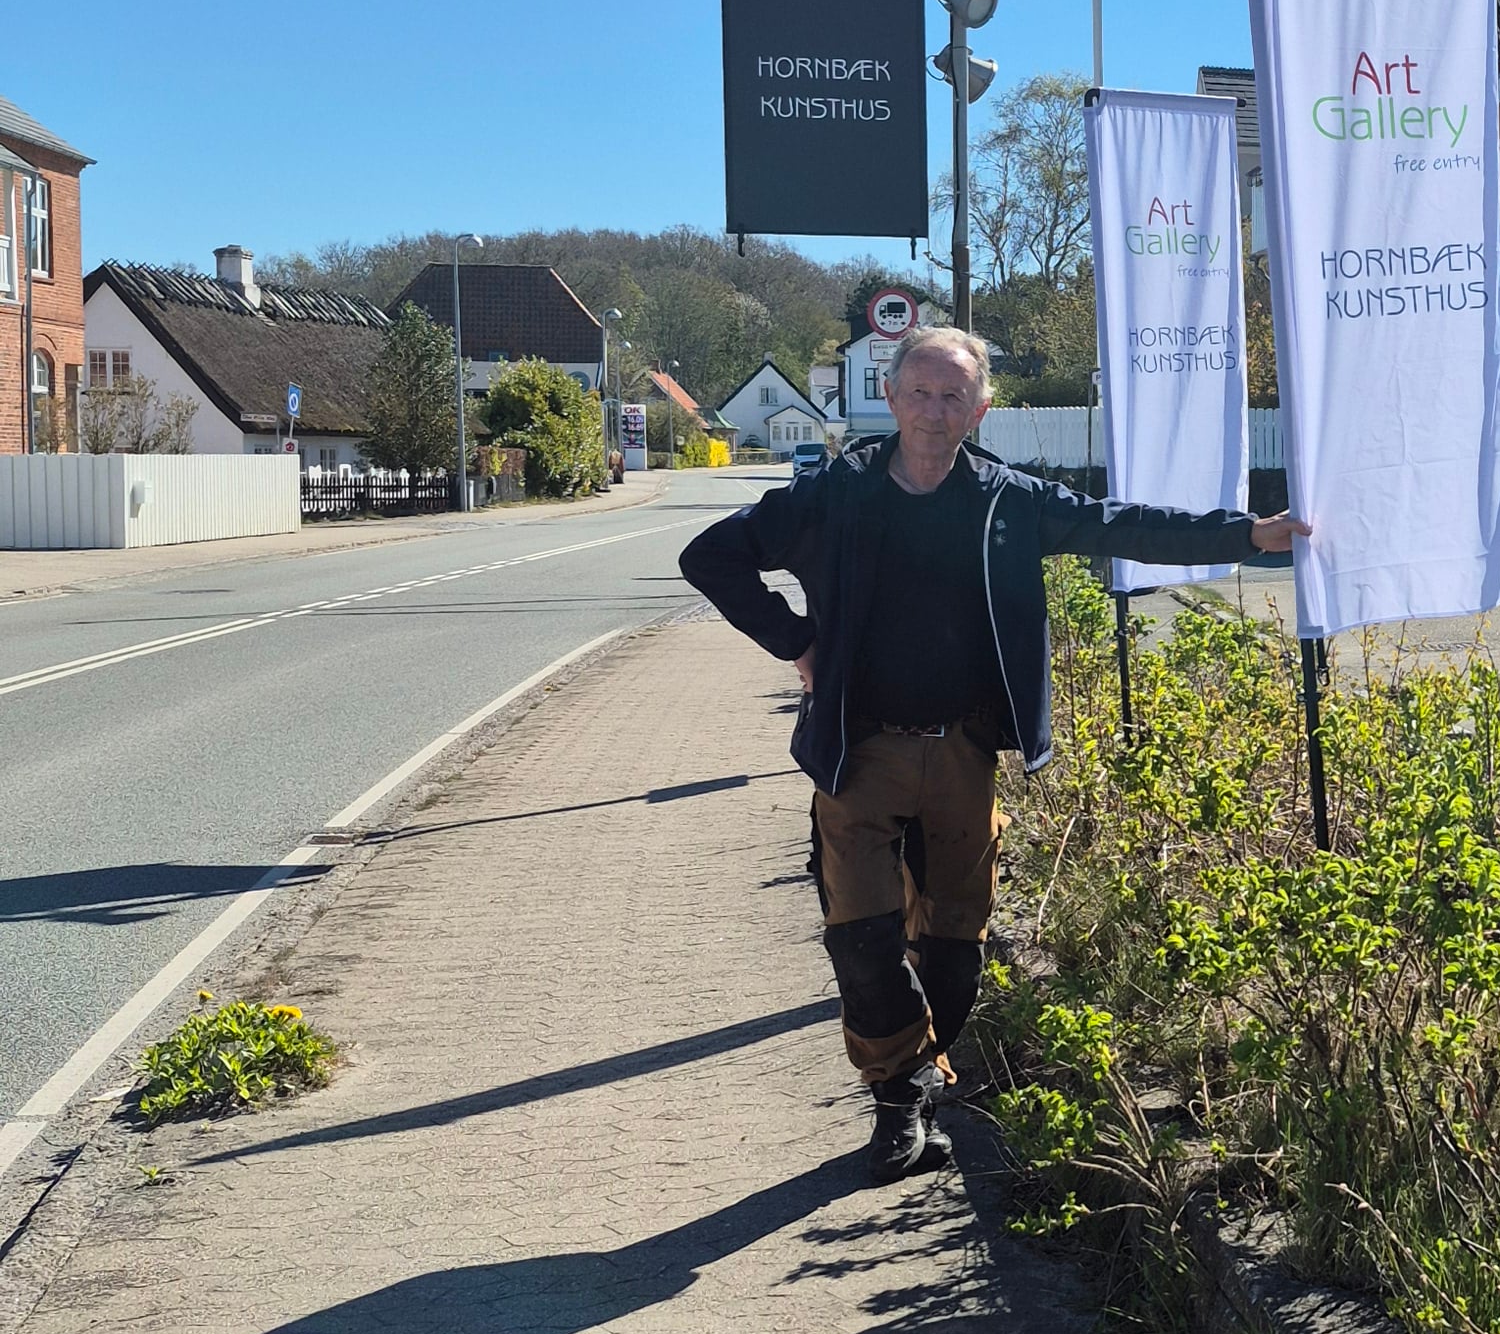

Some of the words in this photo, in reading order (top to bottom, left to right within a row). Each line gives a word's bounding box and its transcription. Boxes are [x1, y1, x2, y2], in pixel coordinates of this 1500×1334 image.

[758, 55, 892, 82] HORNBÆK
[1352, 51, 1421, 95] Art
[761, 95, 892, 121] KUNSTHUS
[1312, 95, 1468, 148] Gallery
[1393, 154, 1427, 174] free
[1432, 154, 1481, 172] entry
[1148, 196, 1195, 226] Art
[1125, 225, 1221, 264] Gallery
[1177, 265, 1198, 278] free
[1200, 266, 1230, 279] entry
[1321, 242, 1487, 280] HORNBÆK
[1326, 281, 1489, 320] KUNSTHUS
[1128, 325, 1236, 348] HORNBÆK
[1131, 350, 1237, 374] KUNSTHUS
